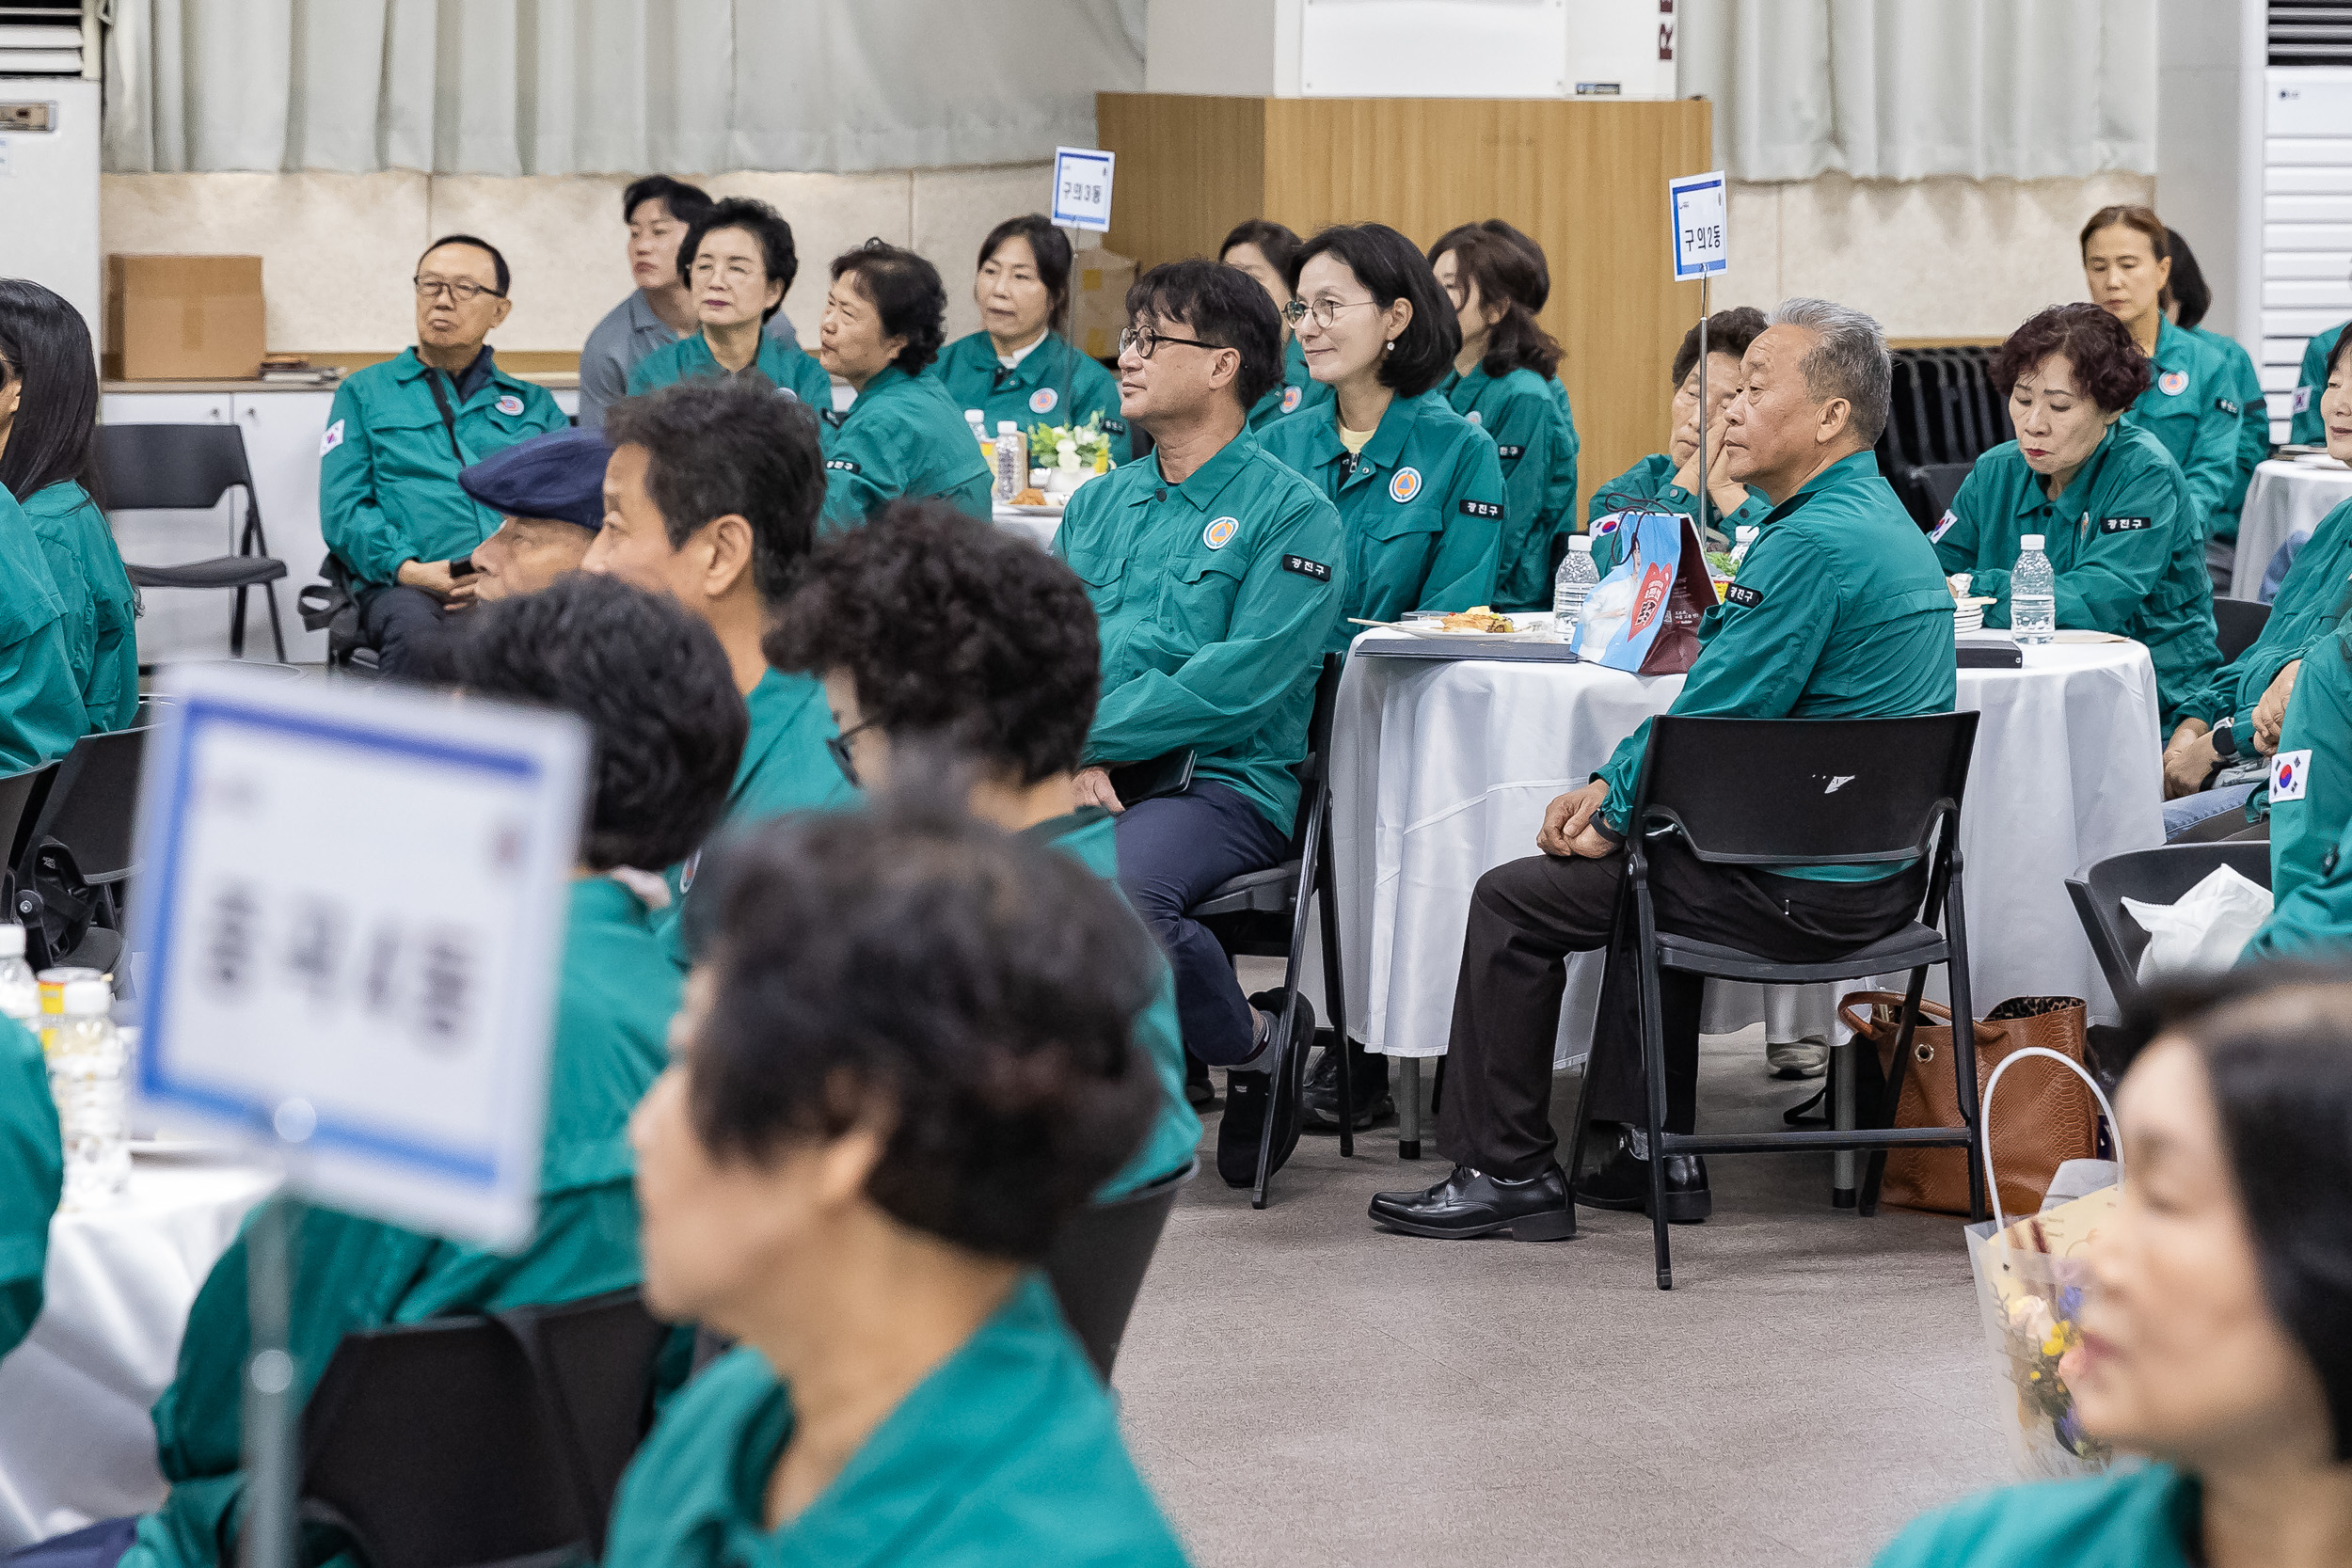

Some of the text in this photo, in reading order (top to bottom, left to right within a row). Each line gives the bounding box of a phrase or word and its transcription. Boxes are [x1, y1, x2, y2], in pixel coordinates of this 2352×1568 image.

[1685, 225, 1721, 252] 구의2동
[2107, 518, 2142, 530] 광진구
[1291, 557, 1325, 576] 광진구
